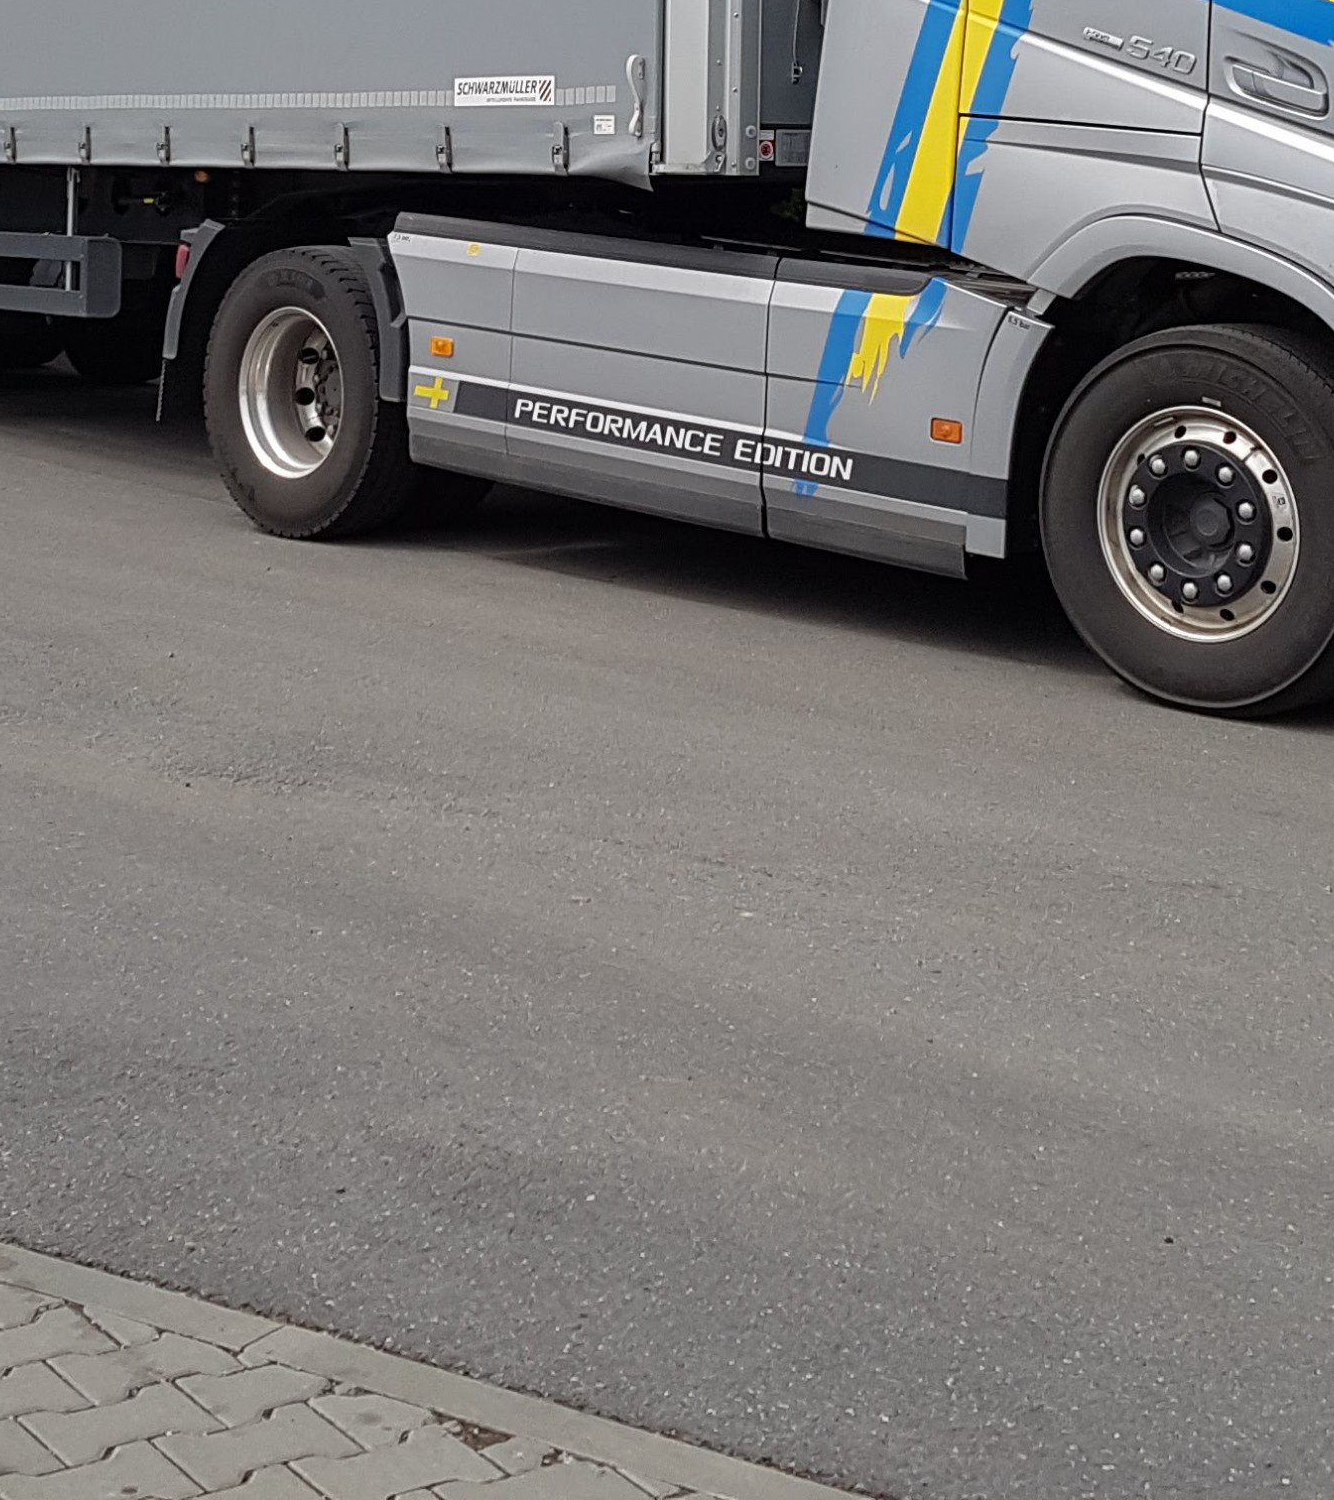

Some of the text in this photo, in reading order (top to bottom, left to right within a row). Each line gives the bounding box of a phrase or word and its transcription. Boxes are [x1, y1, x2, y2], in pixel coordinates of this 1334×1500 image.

[1127, 35, 1198, 75] 540
[456, 80, 537, 95] SCHWARZMÜLLER
[513, 397, 854, 481] PERFORMANCE EDITION
